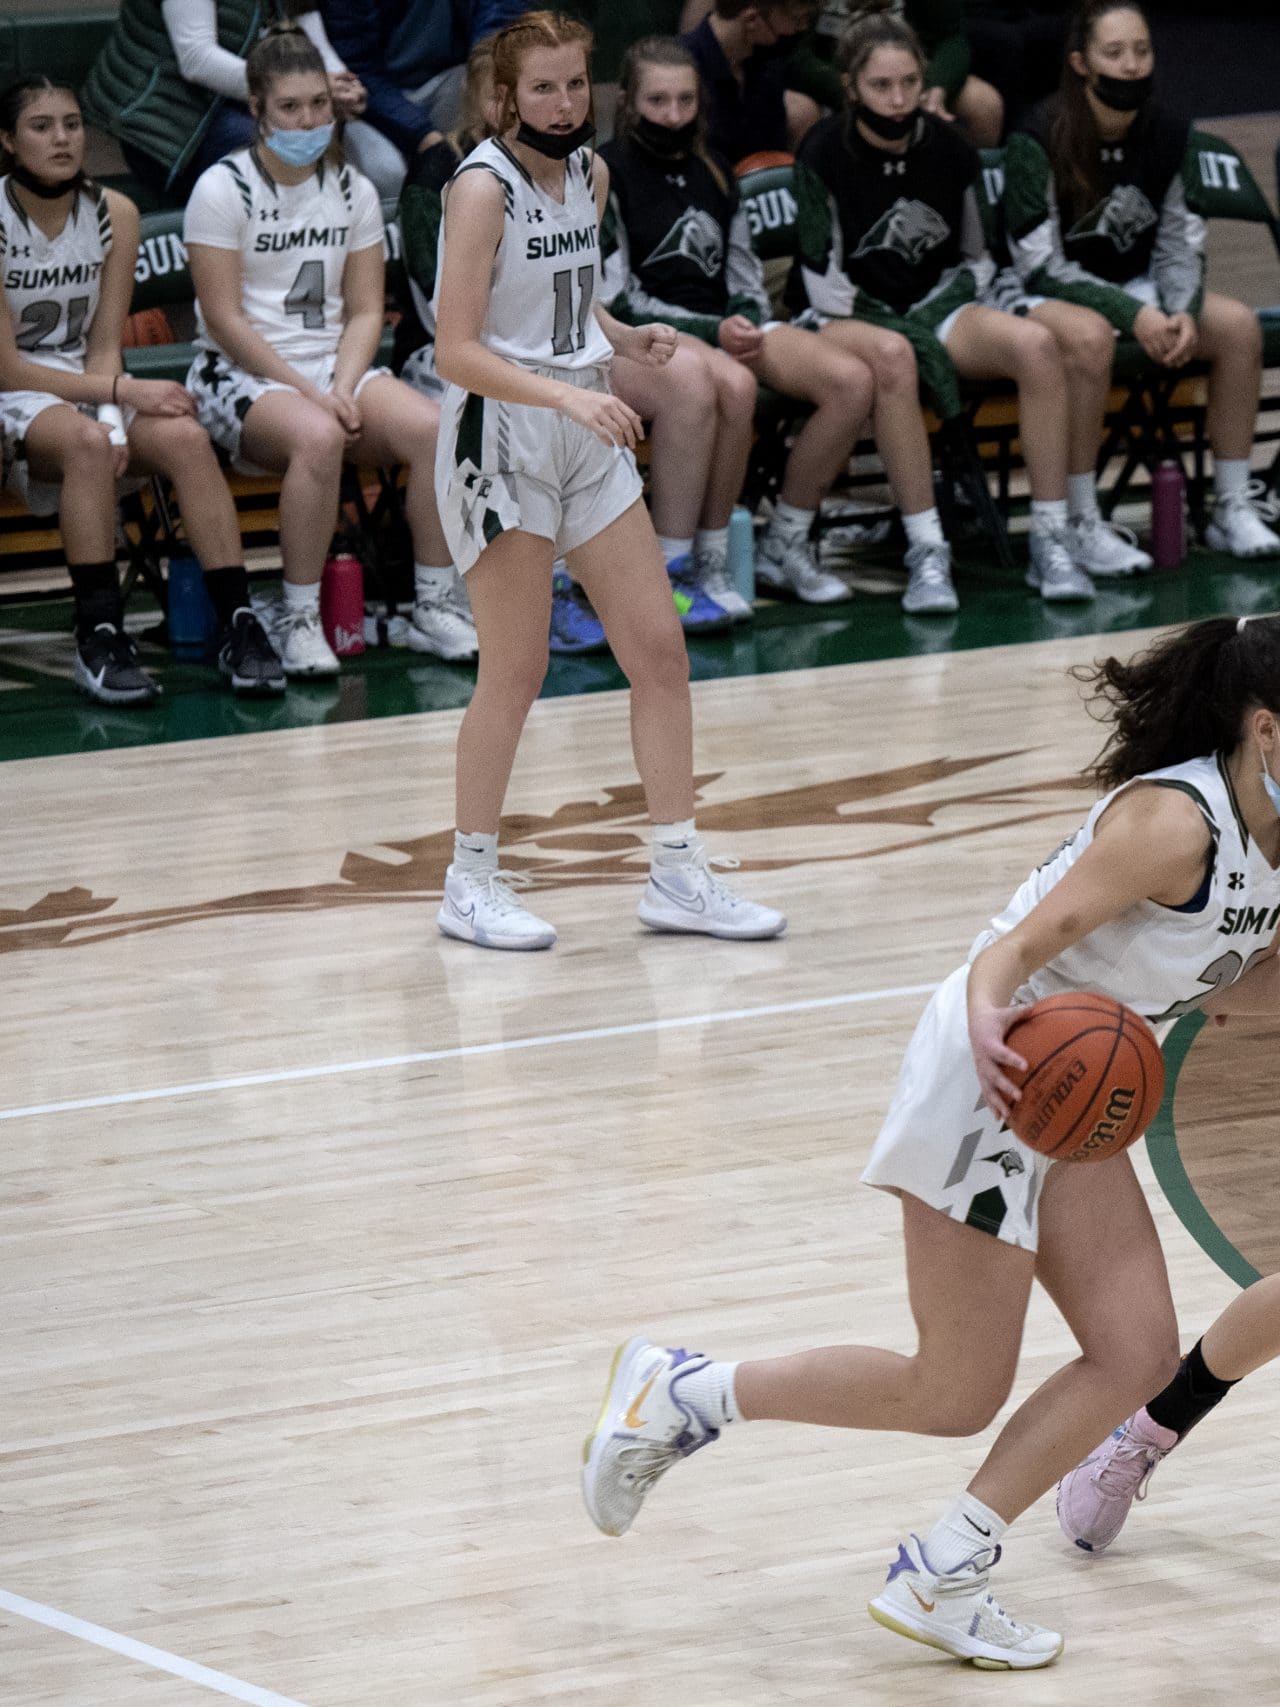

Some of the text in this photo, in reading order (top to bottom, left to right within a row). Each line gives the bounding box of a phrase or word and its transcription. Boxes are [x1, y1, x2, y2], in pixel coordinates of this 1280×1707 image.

[254, 226, 349, 252] SUMMIT
[526, 224, 597, 260] SUMMI
[5, 261, 102, 290] SUMMIT
[284, 260, 325, 329] 4
[16, 295, 90, 352] 21
[551, 264, 594, 356] 11
[1071, 1086, 1137, 1163] Wilso
